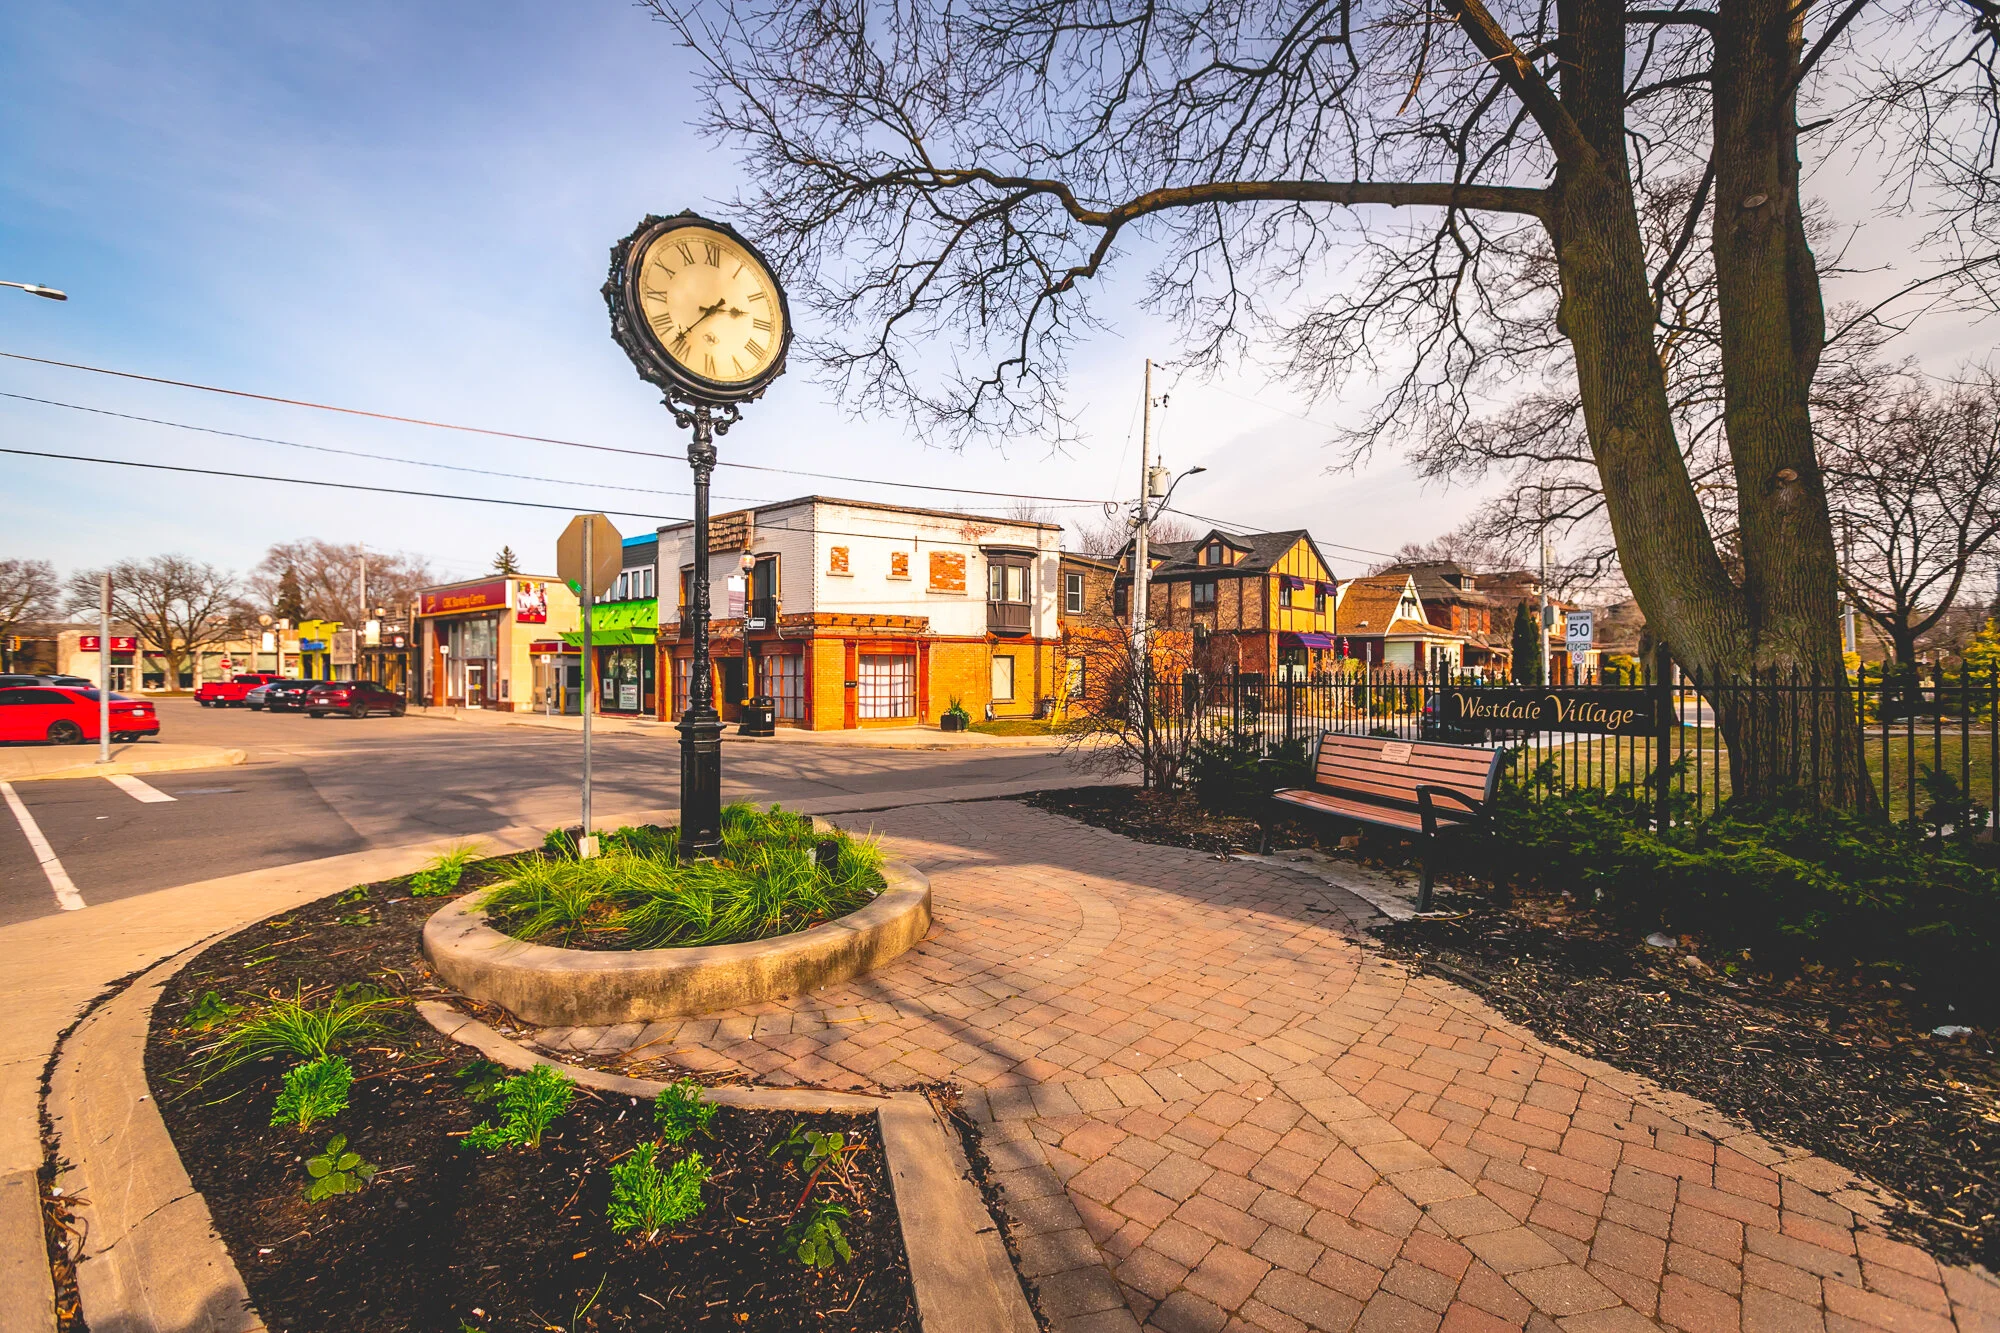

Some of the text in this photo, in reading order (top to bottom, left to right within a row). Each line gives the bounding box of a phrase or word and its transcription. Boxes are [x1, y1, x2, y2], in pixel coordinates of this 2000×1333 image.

[676, 243, 695, 267] XI
[704, 244, 721, 269] XII
[654, 257, 676, 280] X
[732, 264, 743, 280] I
[647, 286, 667, 304] IX
[747, 291, 765, 303] II
[753, 318, 771, 332] III
[1569, 622, 1590, 637] 50
[1451, 692, 1634, 730] Westdale Village
